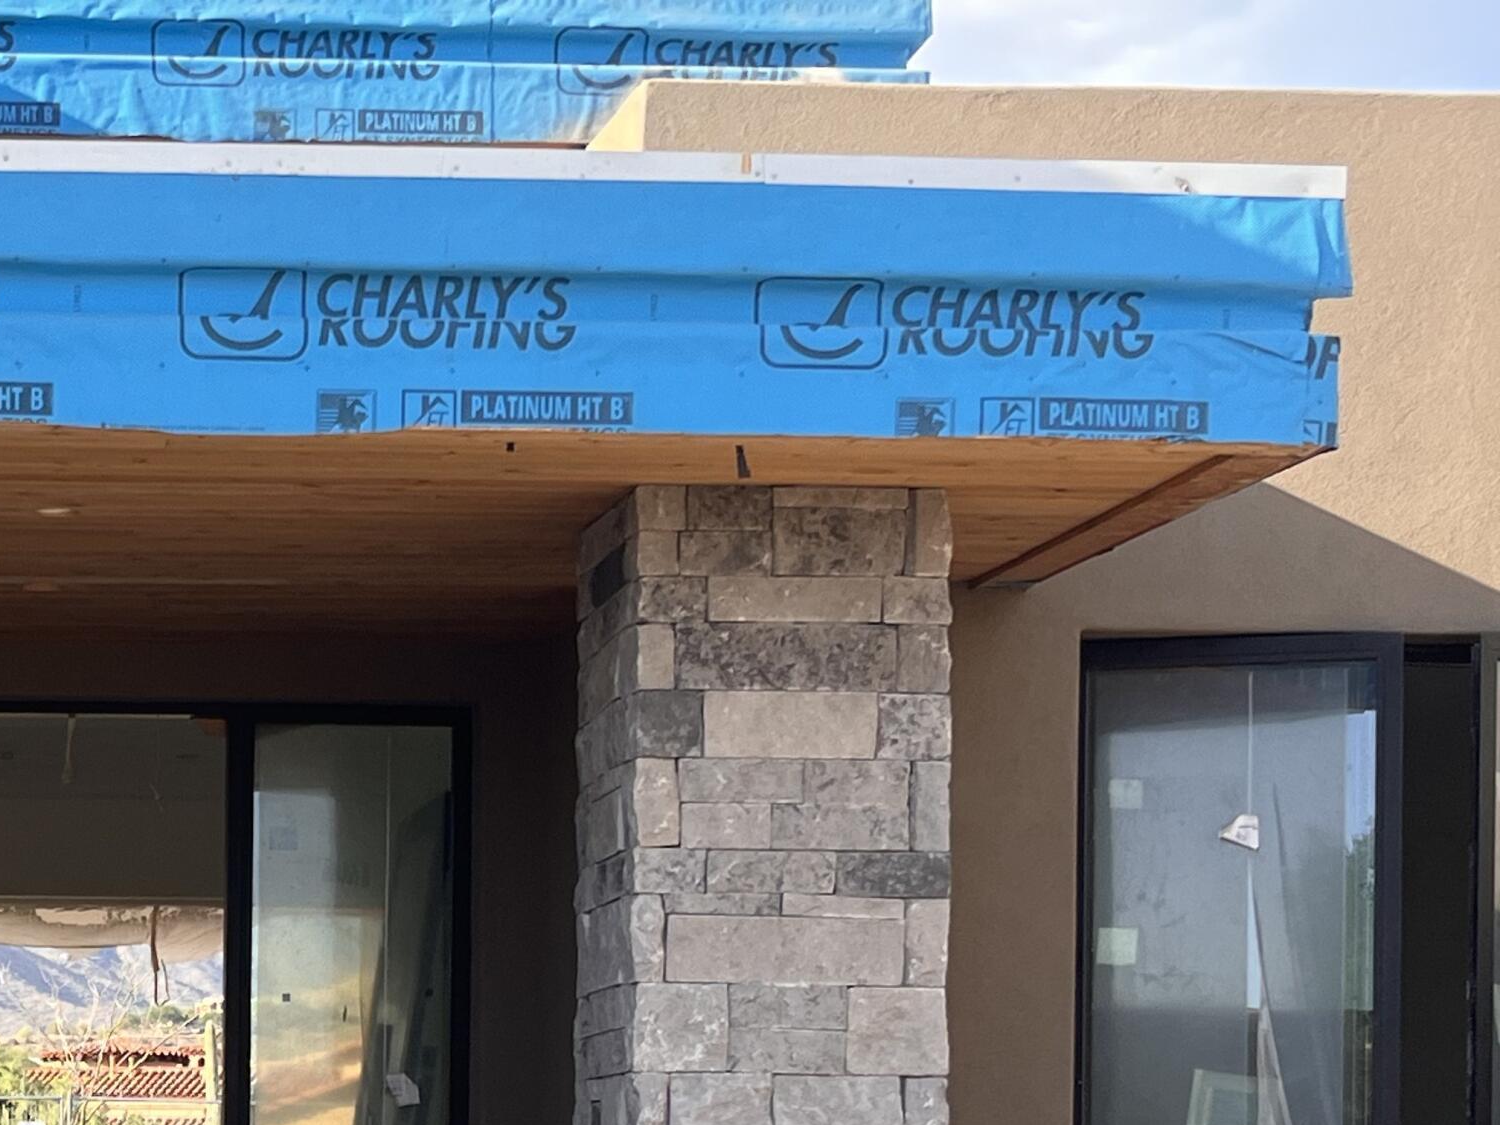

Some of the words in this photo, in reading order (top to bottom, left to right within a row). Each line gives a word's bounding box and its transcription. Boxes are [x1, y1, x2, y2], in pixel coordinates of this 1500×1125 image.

[252, 28, 437, 60] CHARLY'S
[655, 38, 840, 68] CHARLY'S
[20, 105, 38, 123] HT
[43, 106, 53, 123] B
[365, 112, 439, 132] PLATINUM
[443, 113, 461, 132] HT
[466, 114, 476, 132] B
[317, 273, 571, 320] CHARLY'S
[892, 285, 1145, 331] CHARLY'S
[31, 387, 43, 411] B
[471, 395, 571, 420] PLATINUM
[578, 396, 603, 420] HT
[610, 397, 623, 420] B
[1050, 402, 1147, 428] PLATINUM
[1155, 404, 1179, 428] HT
[1186, 406, 1199, 430] B
